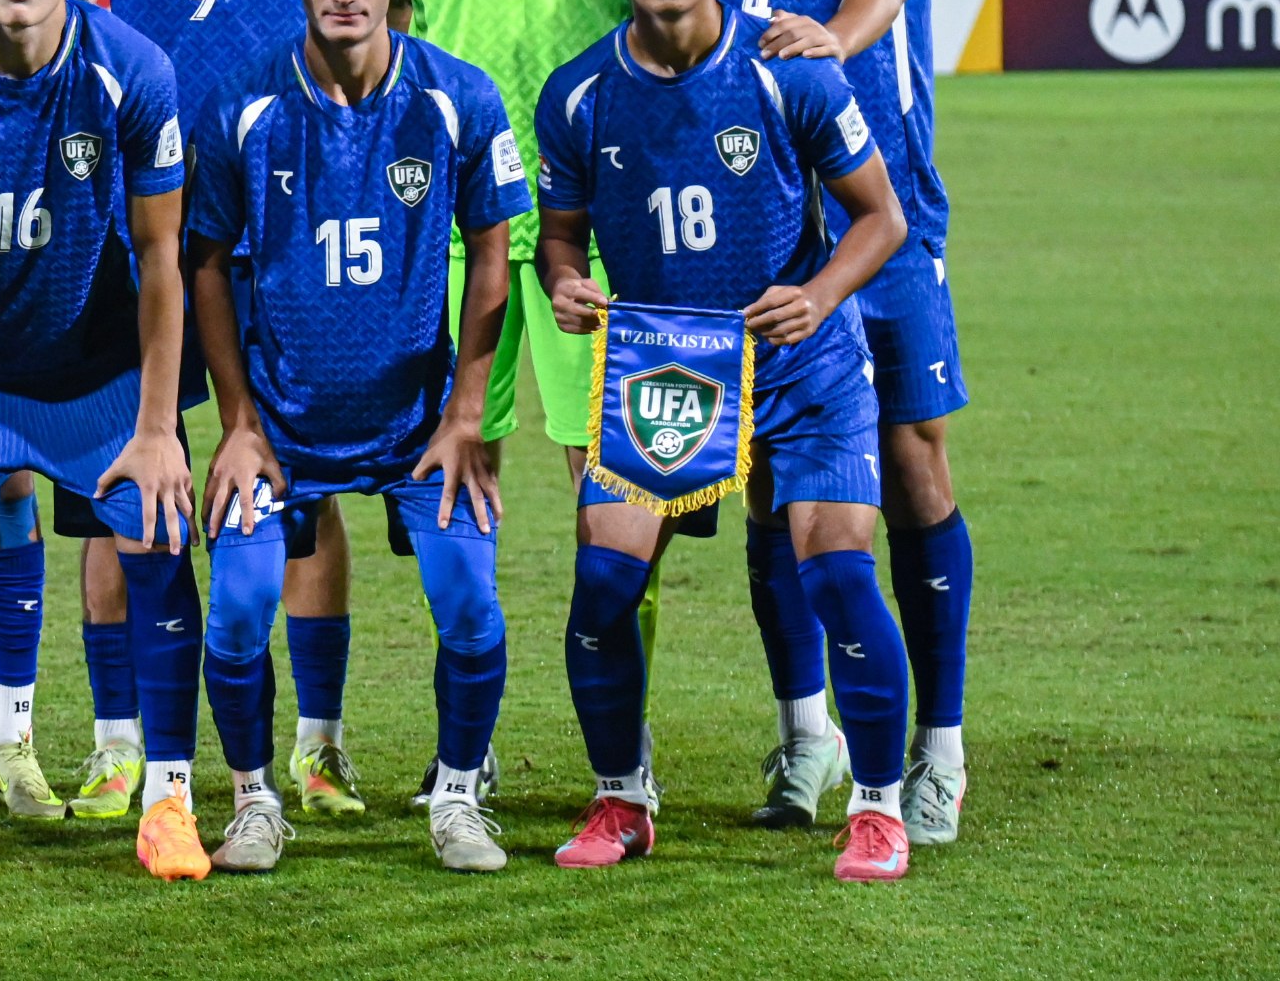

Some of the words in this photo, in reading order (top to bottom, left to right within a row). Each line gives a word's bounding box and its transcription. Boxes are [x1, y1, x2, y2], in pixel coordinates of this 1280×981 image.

[66, 142, 96, 158] UFA
[723, 136, 754, 153] UFA
[394, 167, 426, 184] UFA
[648, 185, 717, 254] 18
[316, 217, 384, 287] 15
[621, 330, 734, 350] UZBEKISTAN
[640, 386, 703, 423] UFA
[650, 420, 691, 428] ASSOCIATION
[14, 700, 30, 713] 19
[166, 771, 186, 784] 16
[602, 779, 624, 791] 18
[240, 782, 262, 794] 15
[444, 782, 466, 795] 15
[860, 788, 882, 802] 18
